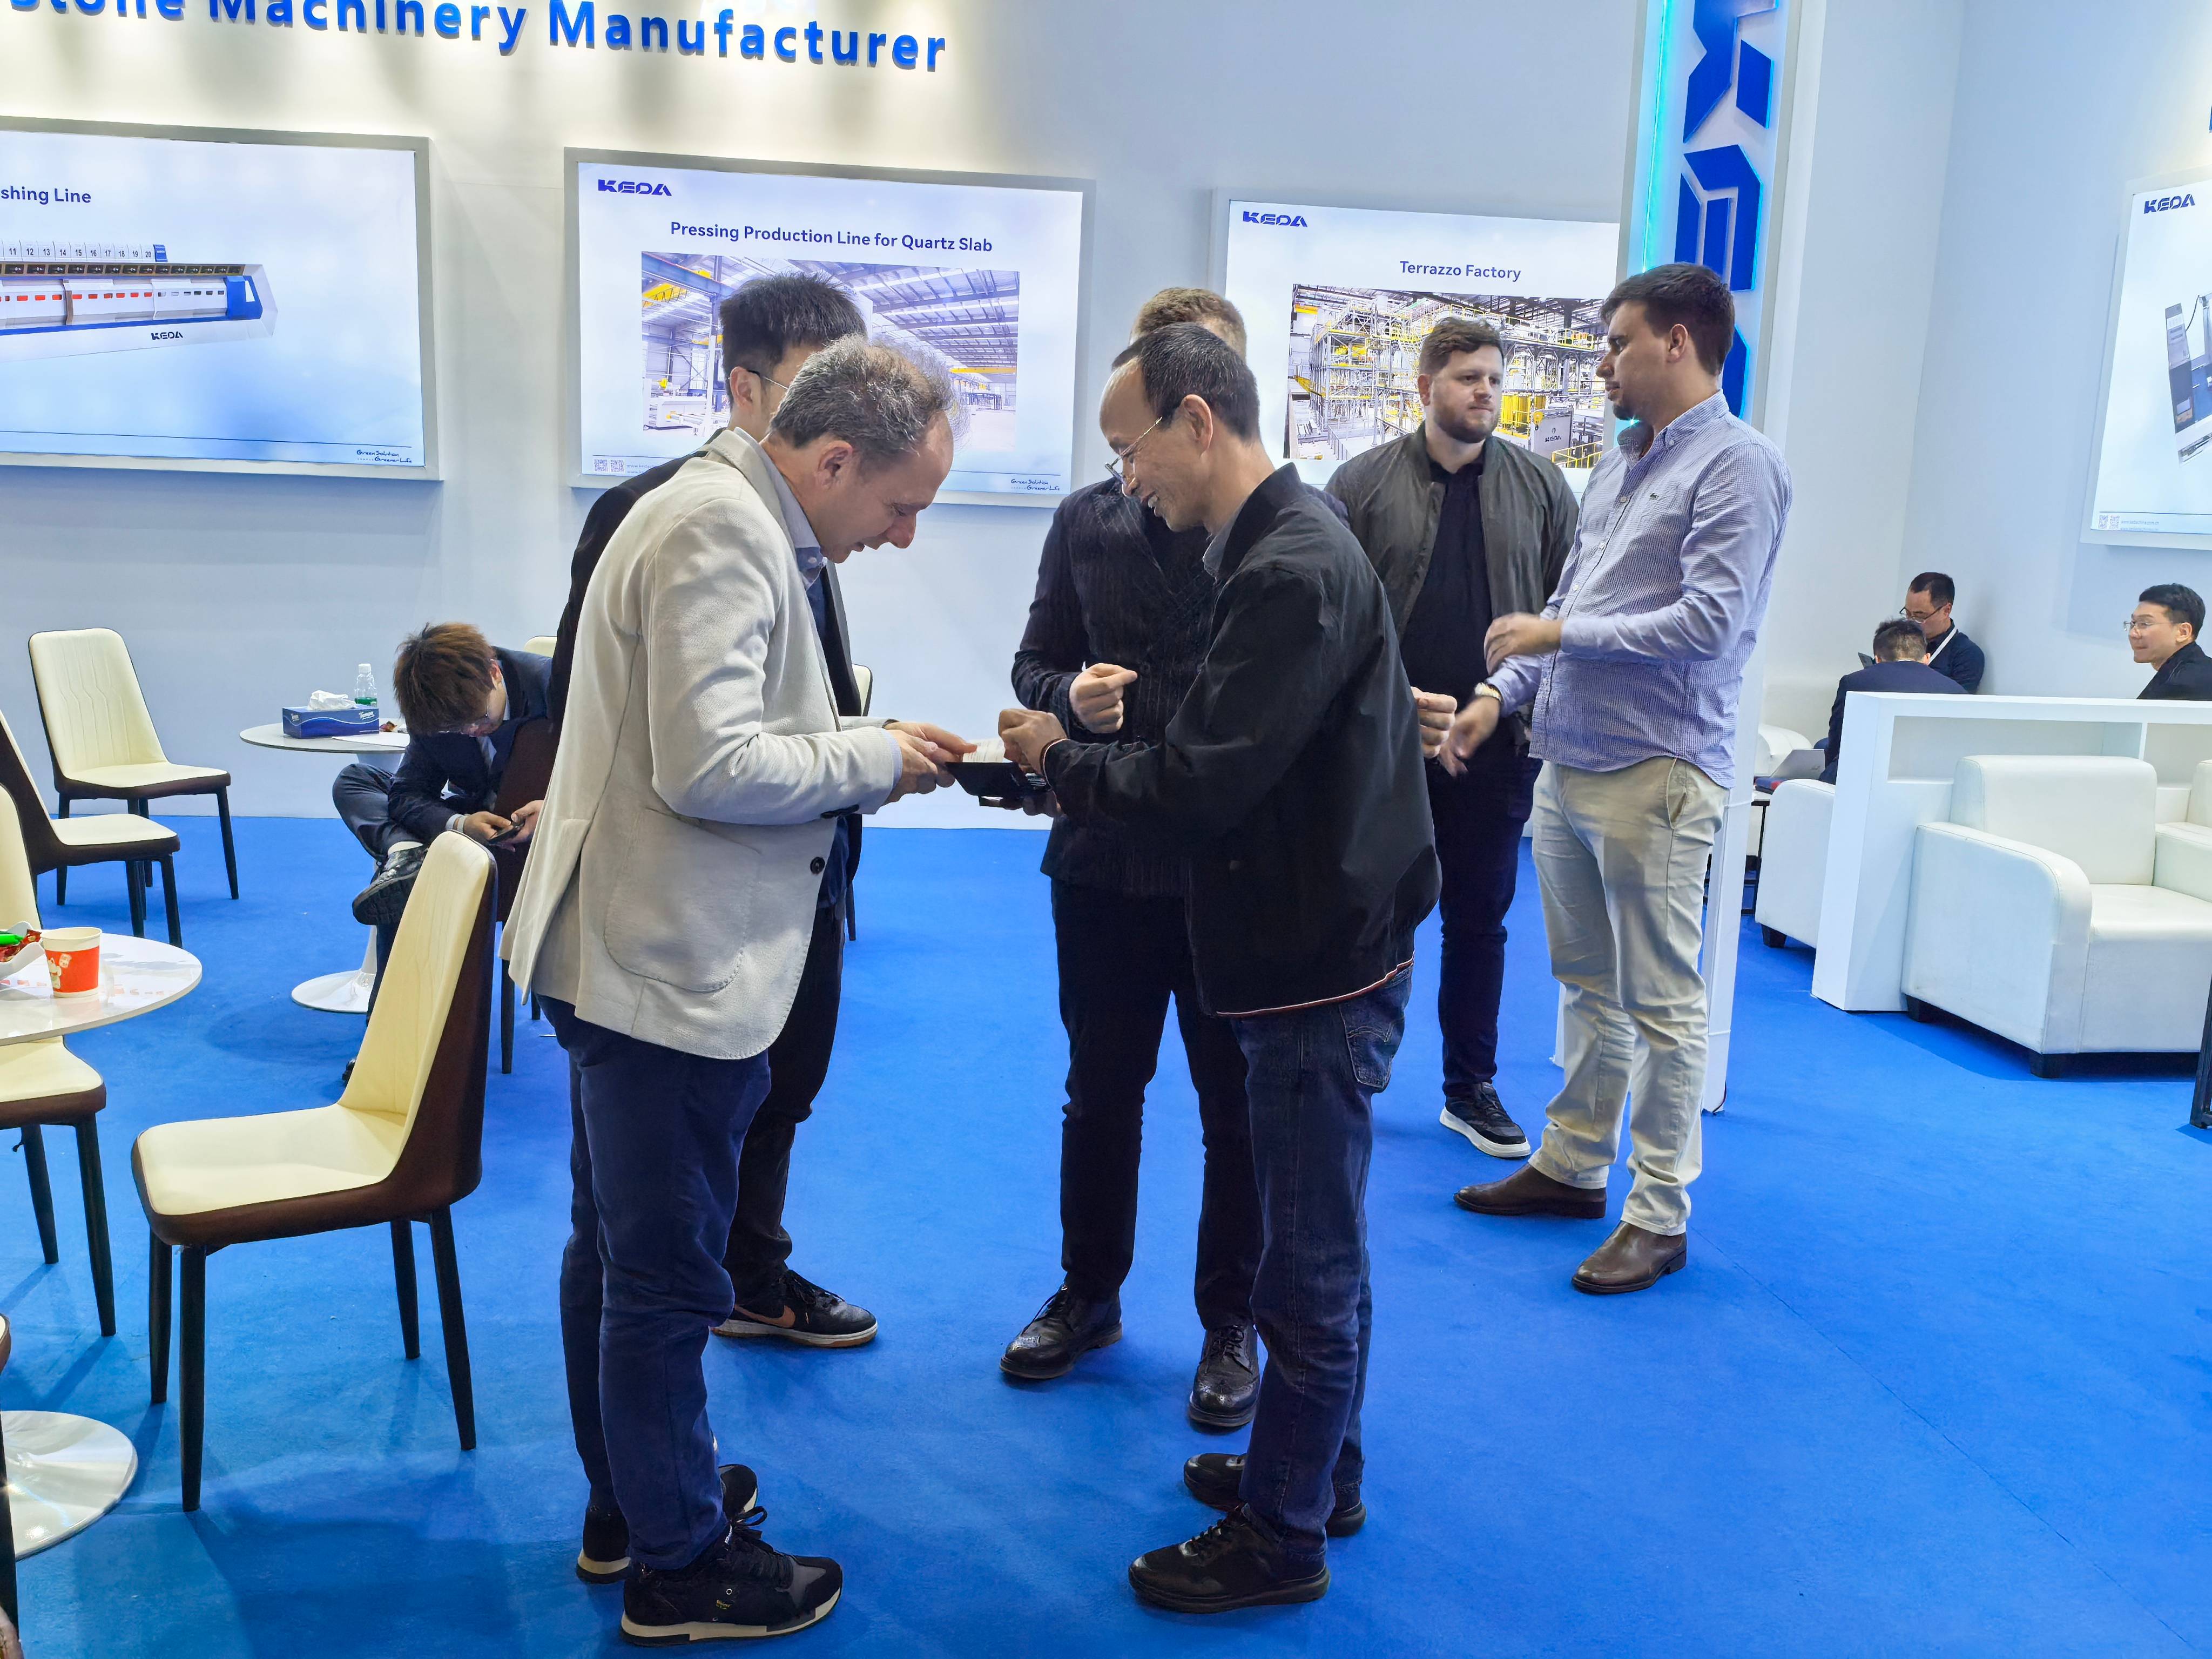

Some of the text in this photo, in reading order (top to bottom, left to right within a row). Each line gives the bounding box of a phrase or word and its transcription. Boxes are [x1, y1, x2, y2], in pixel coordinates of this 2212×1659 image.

[549, 1, 945, 72] Manufacturer
[55, 188, 91, 203] Line
[598, 179, 672, 196] KEDA
[2144, 193, 2195, 214] KEDA
[1243, 211, 1307, 227] KEDA
[671, 221, 992, 252] Pressing Production Line for Quartz Slab
[1400, 261, 1521, 282] Terrazzo Factory
[151, 331, 183, 340] KEDA
